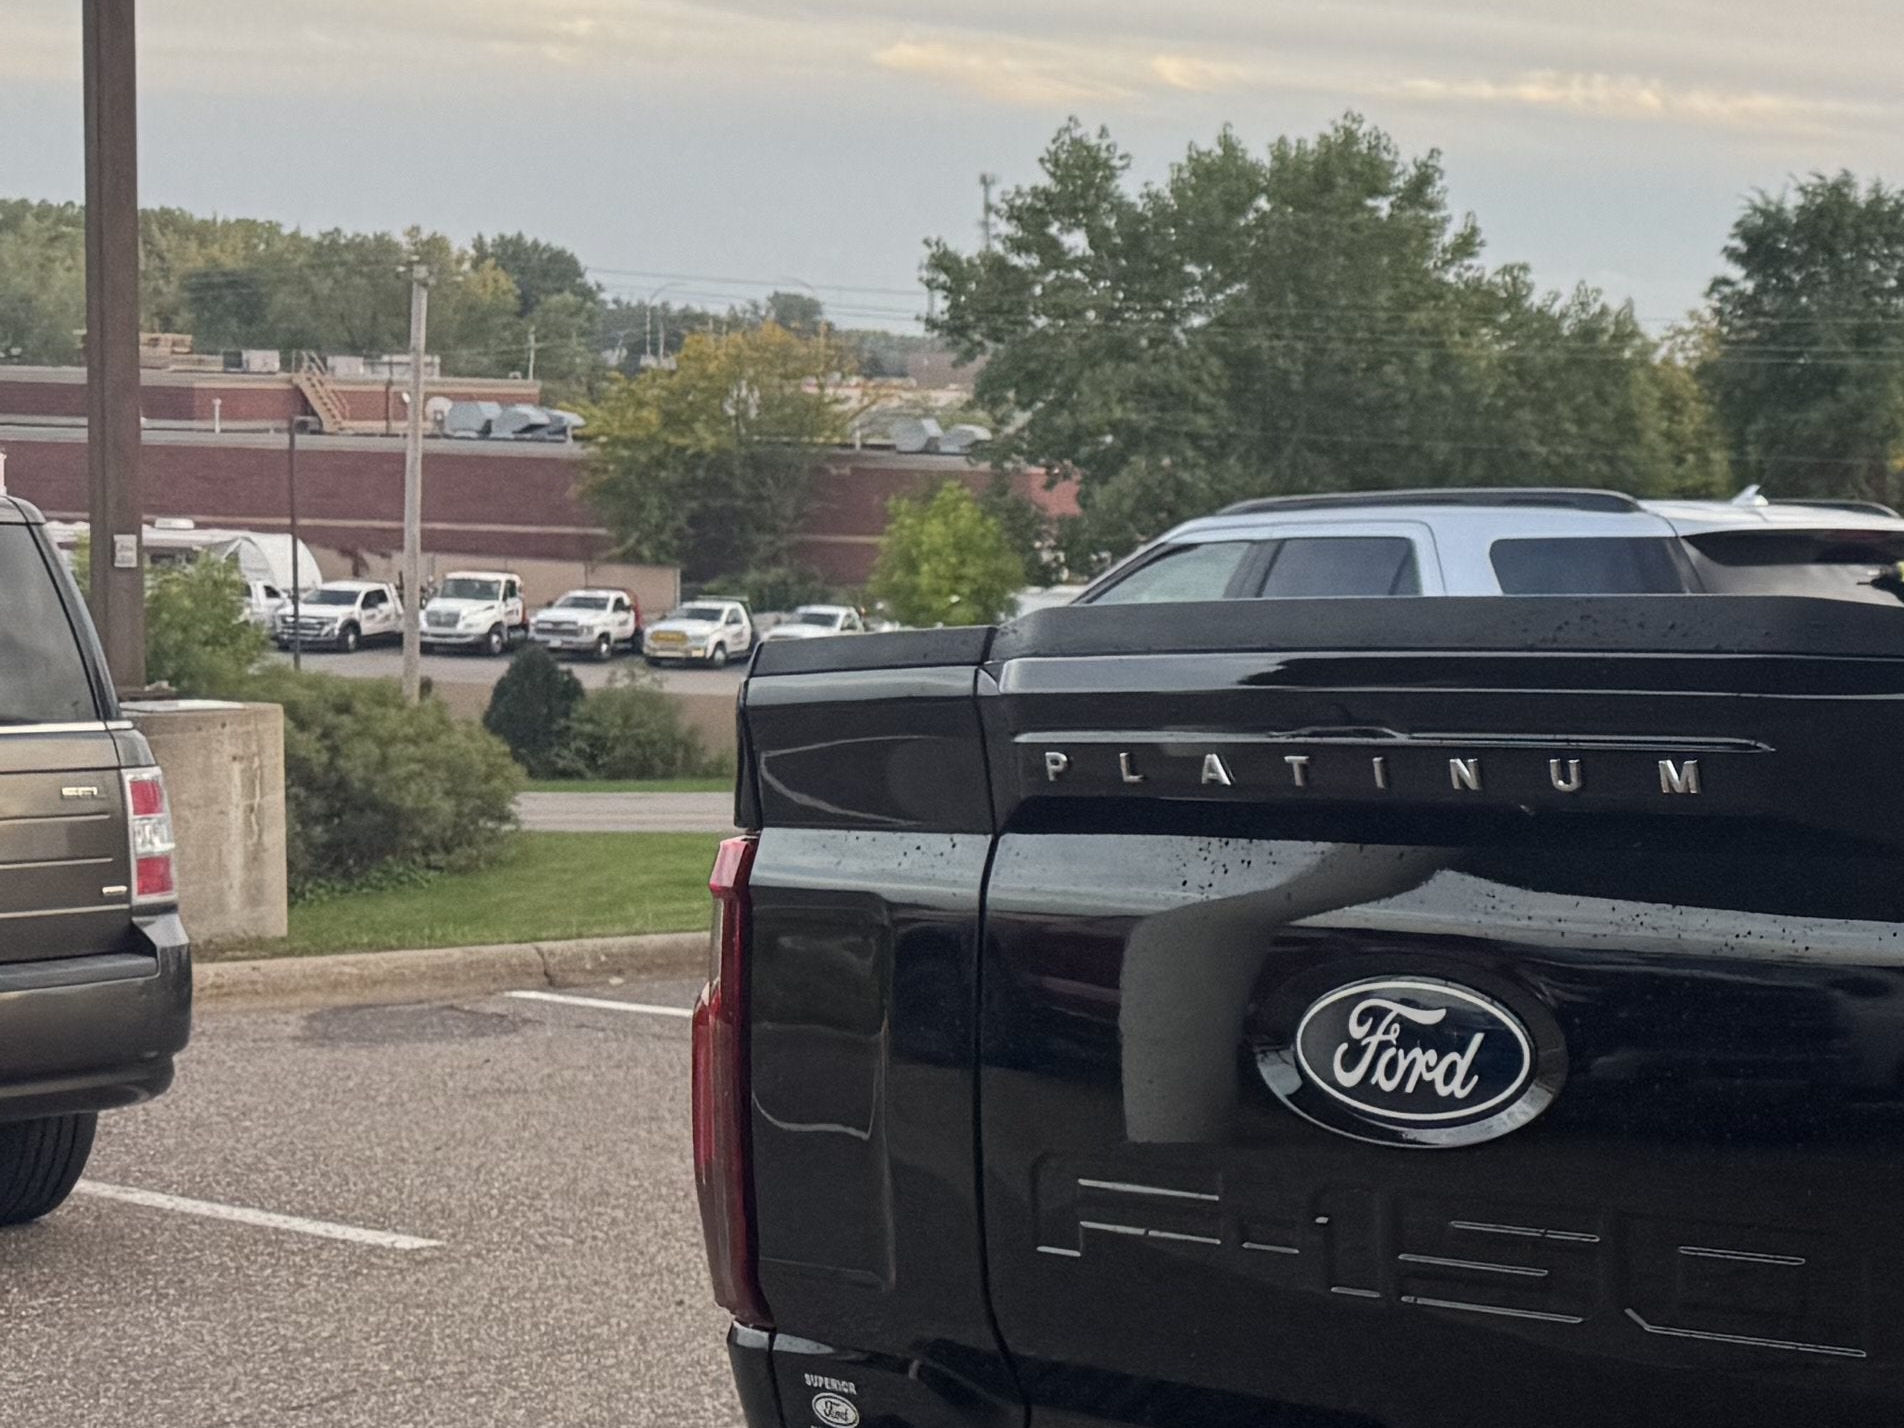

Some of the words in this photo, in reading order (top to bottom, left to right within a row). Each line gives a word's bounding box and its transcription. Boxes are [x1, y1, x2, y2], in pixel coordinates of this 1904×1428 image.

[1043, 749, 1703, 796] PLATINUM
[1333, 997, 1485, 1101] Ford
[804, 1373, 857, 1395] SUPERIOR
[823, 1399, 849, 1422] Ford
